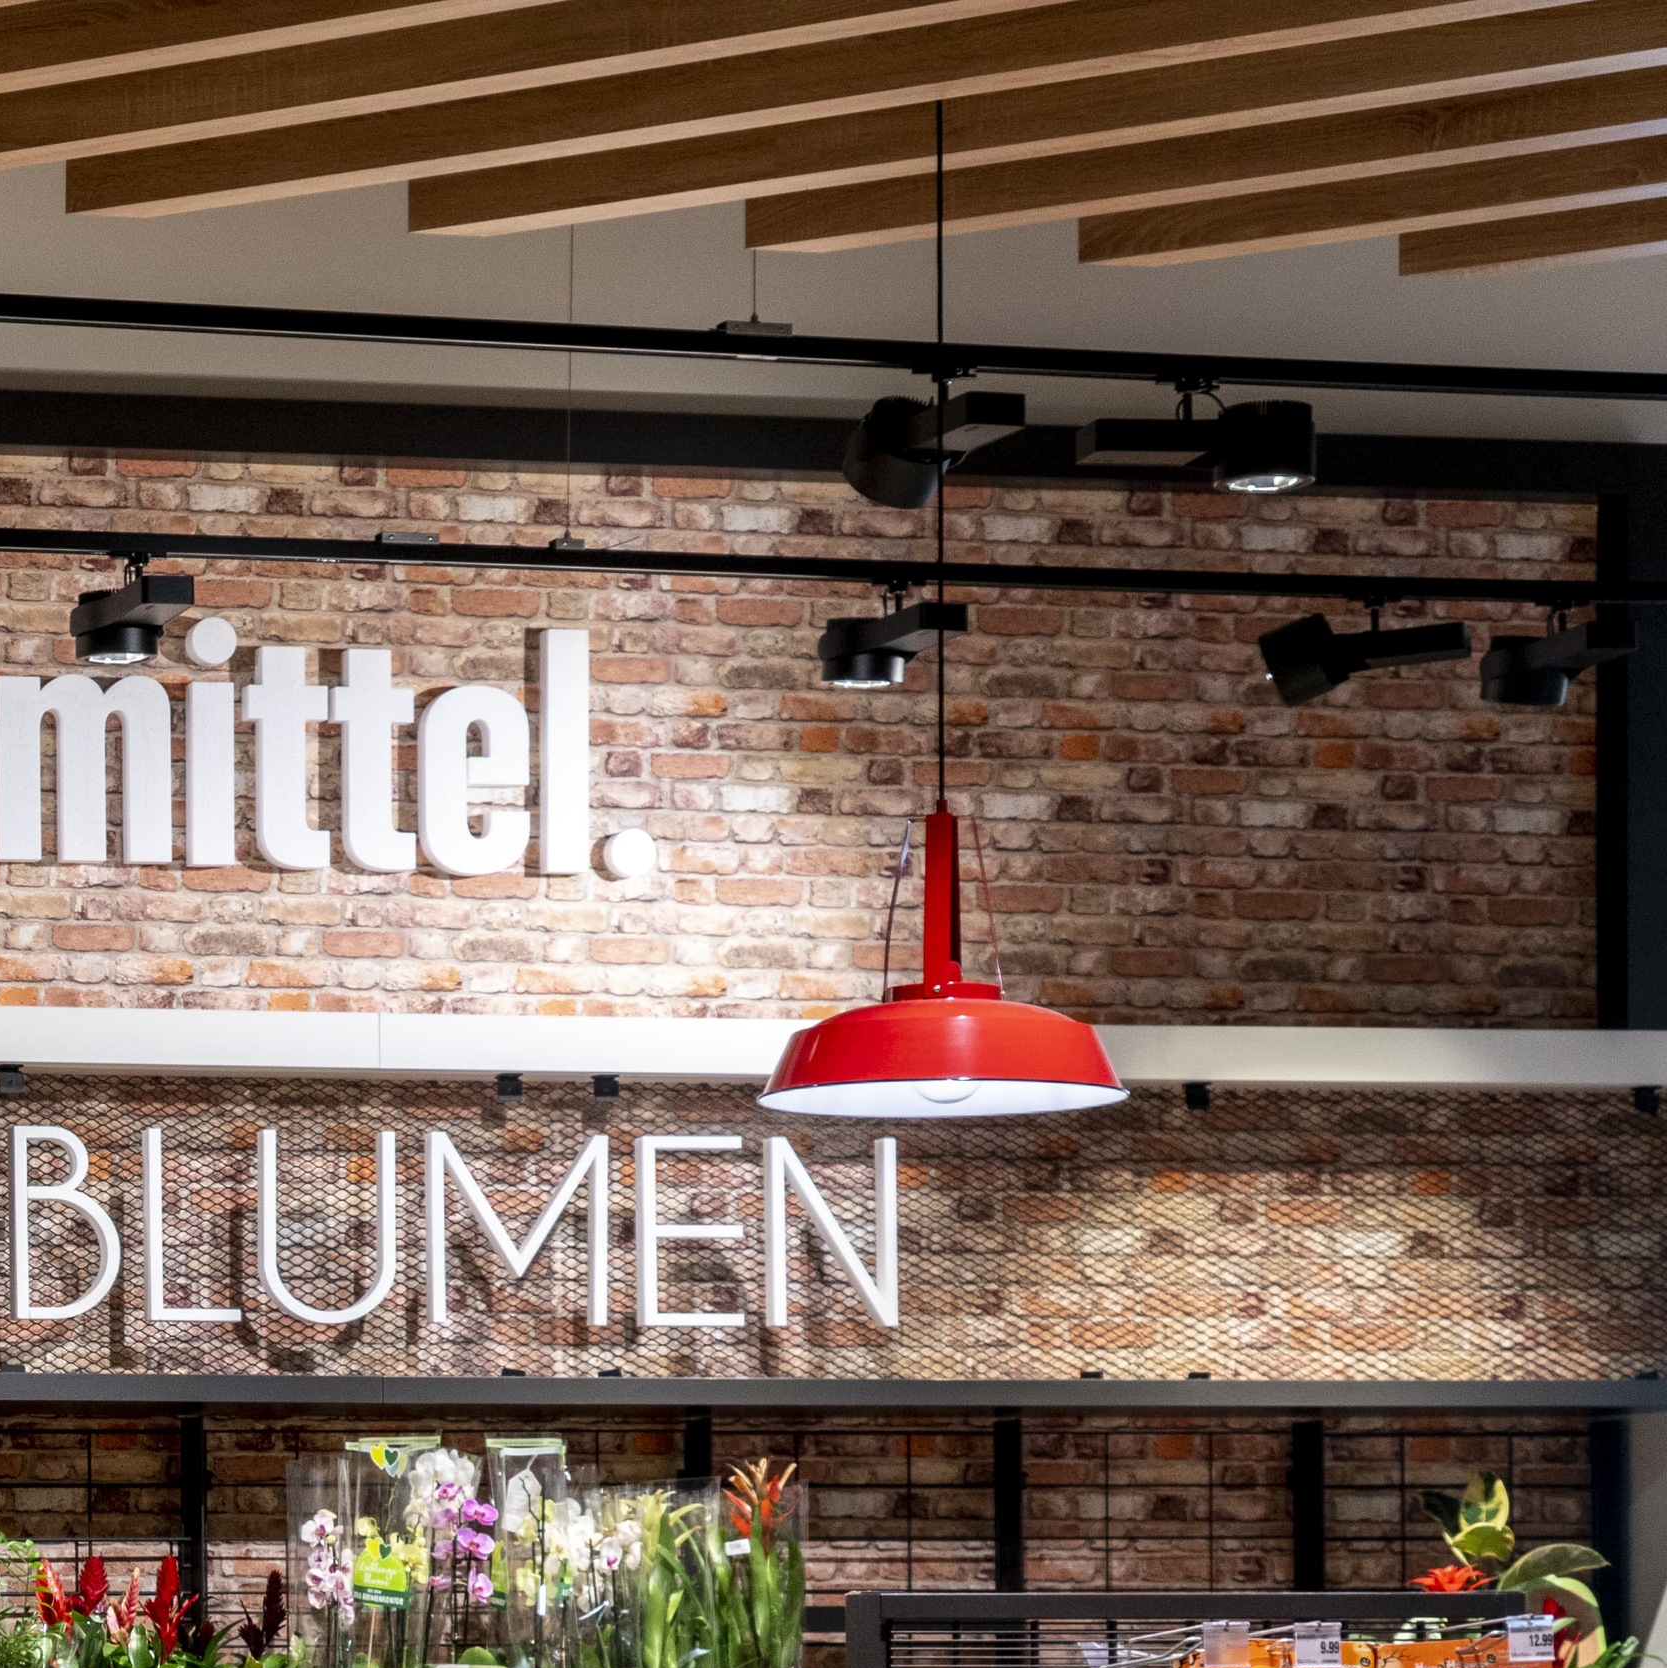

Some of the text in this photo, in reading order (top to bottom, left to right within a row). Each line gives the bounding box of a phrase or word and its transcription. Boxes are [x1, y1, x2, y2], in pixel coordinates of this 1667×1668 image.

[8, 1125, 899, 1326] BLUMEN
[1529, 1634, 1553, 1647] 12.99
[1321, 1641, 1340, 1654] 9.99
